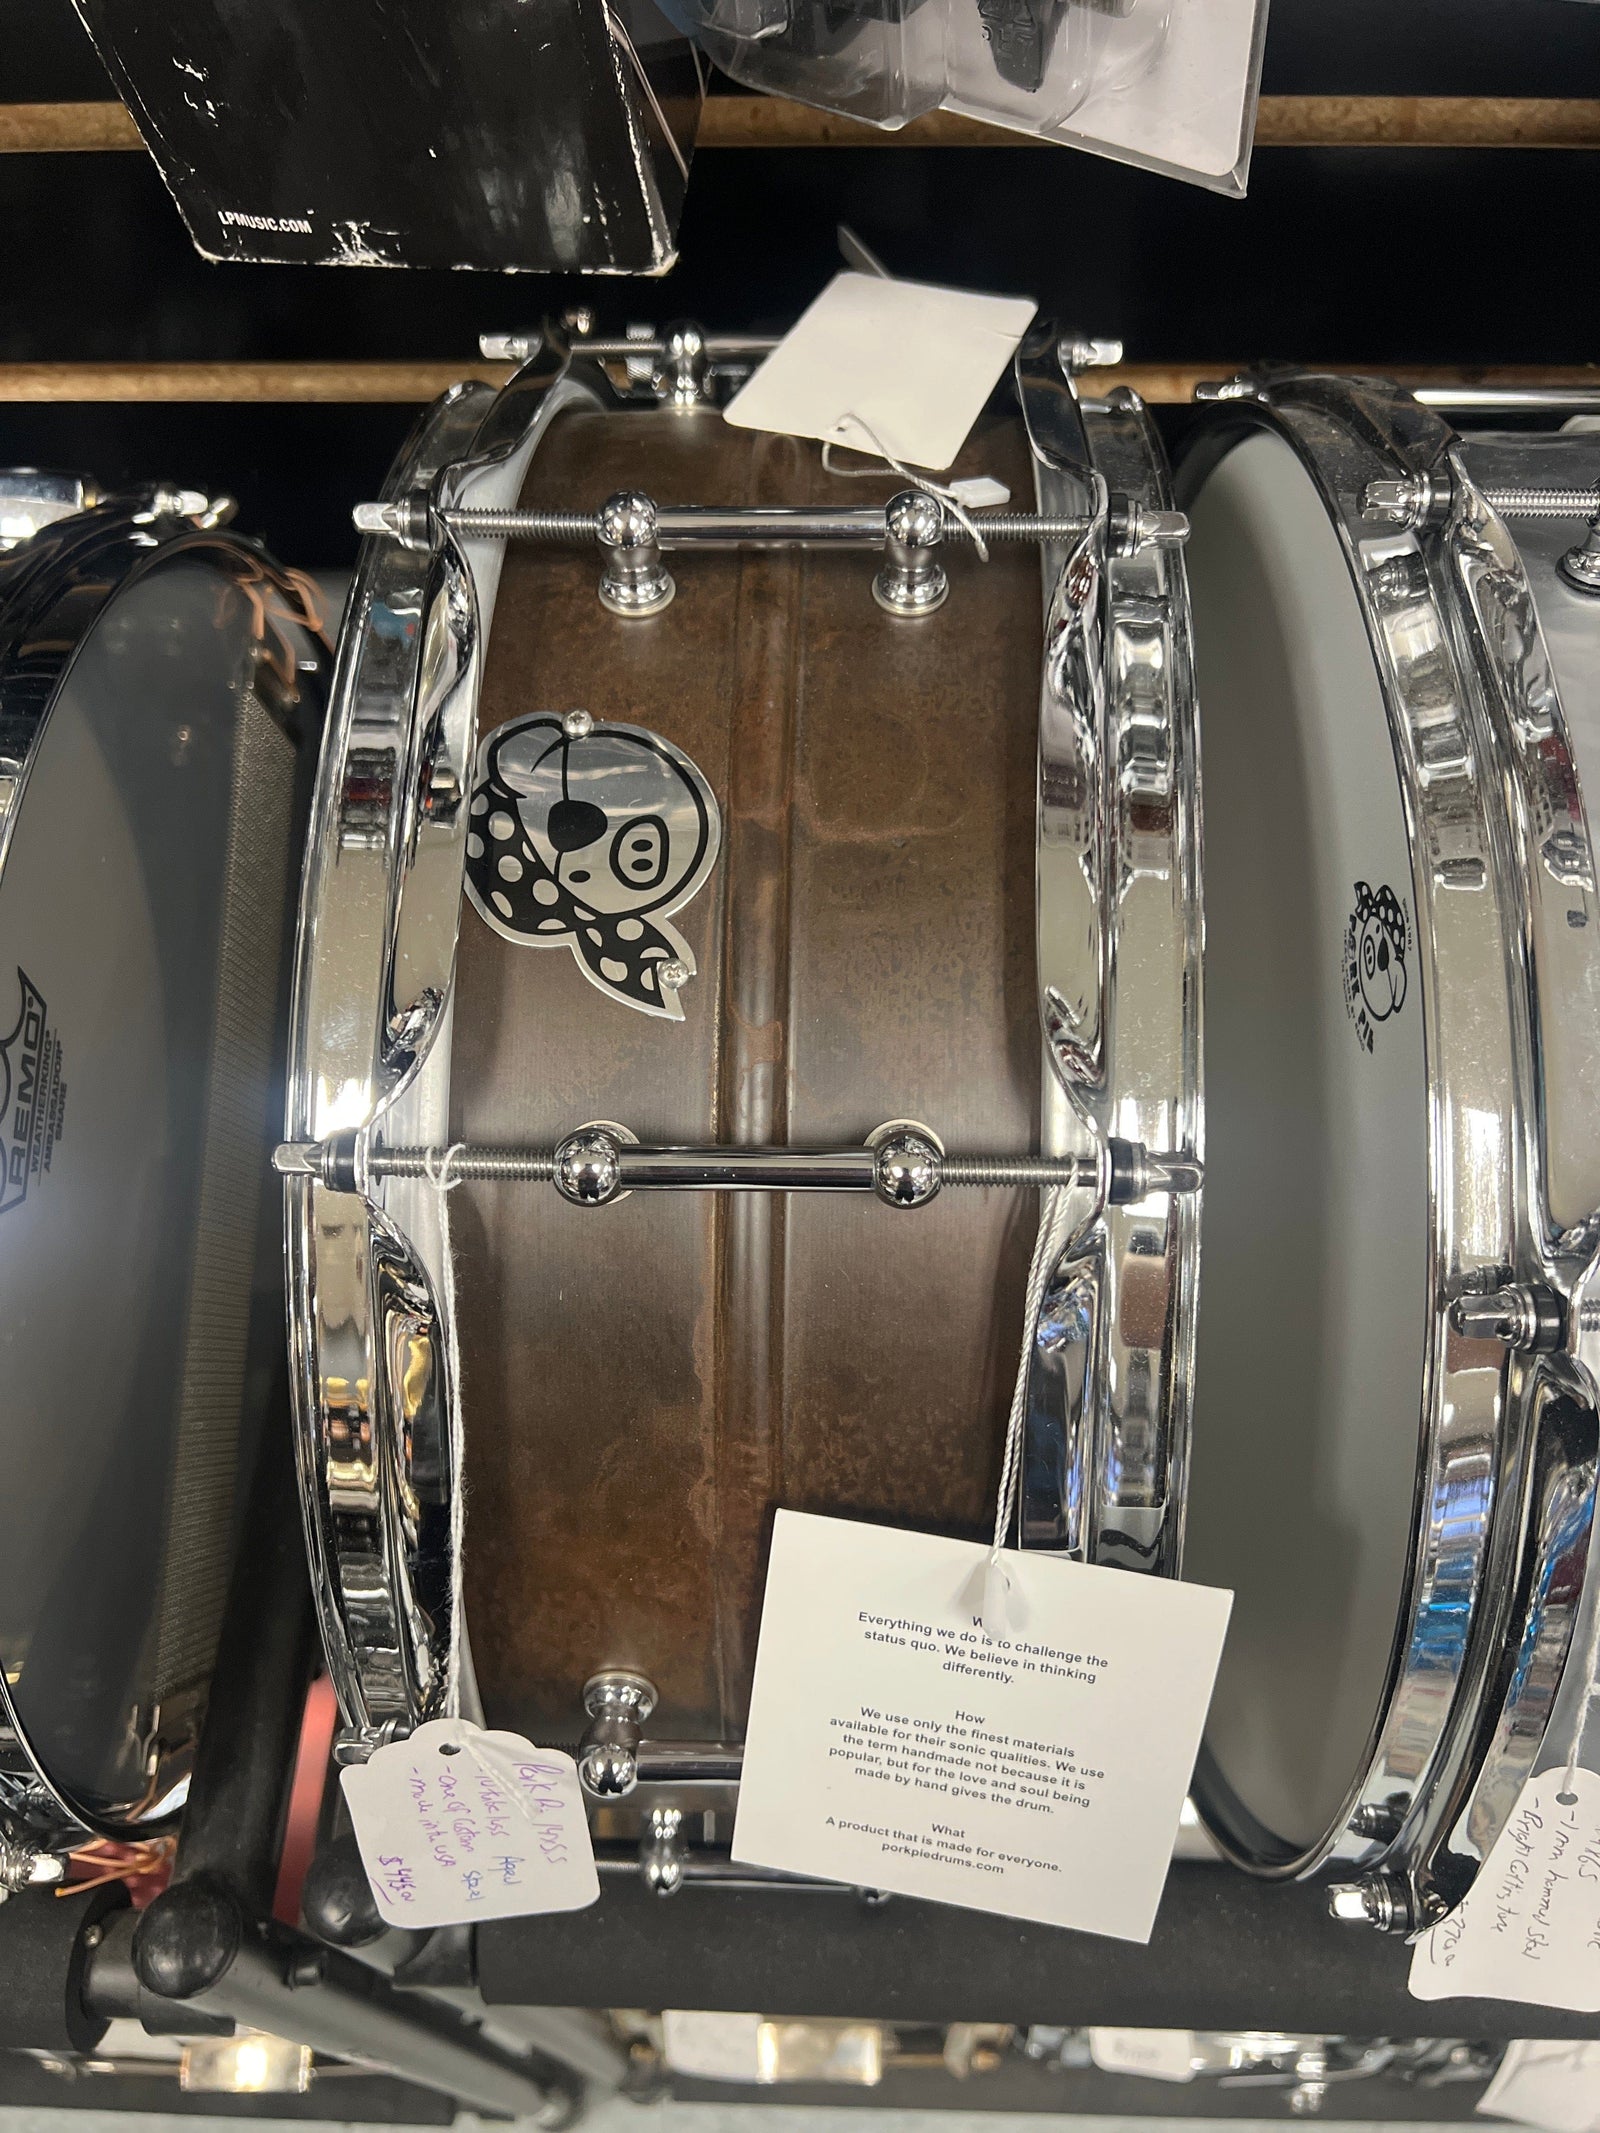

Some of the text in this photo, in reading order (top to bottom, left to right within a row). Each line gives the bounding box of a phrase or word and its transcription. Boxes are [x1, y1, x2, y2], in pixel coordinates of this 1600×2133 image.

[218, 210, 313, 234] LPMUSIC.COM
[1342, 977, 1351, 1019] TAIWAN
[1354, 1022, 1365, 1052] REMO
[1358, 1007, 1374, 1055] PIE
[55, 1083, 68, 1142] SNARE
[858, 1610, 1109, 1668] Everything we do is to challenge the
[863, 1630, 1097, 1685] status quo. We believe in thinking
[941, 1660, 1015, 1685] differently.
[860, 1706, 1075, 1758] We use only the finest materials
[954, 1709, 986, 1725] How
[829, 1718, 1105, 1779] available for their sonic qualities. We use
[842, 1733, 1086, 1791] the term handmade not because it is
[512, 1763, 566, 1794] Pork
[828, 1747, 1091, 1809] popular, but for the love and soul being
[854, 1767, 1054, 1814] made by hand gives the drum.
[825, 1816, 1062, 1873] A product that is made for everyone.
[931, 1822, 966, 1839] What
[433, 1845, 457, 1867] USA
[881, 1842, 1004, 1875] porkpiedrums.com
